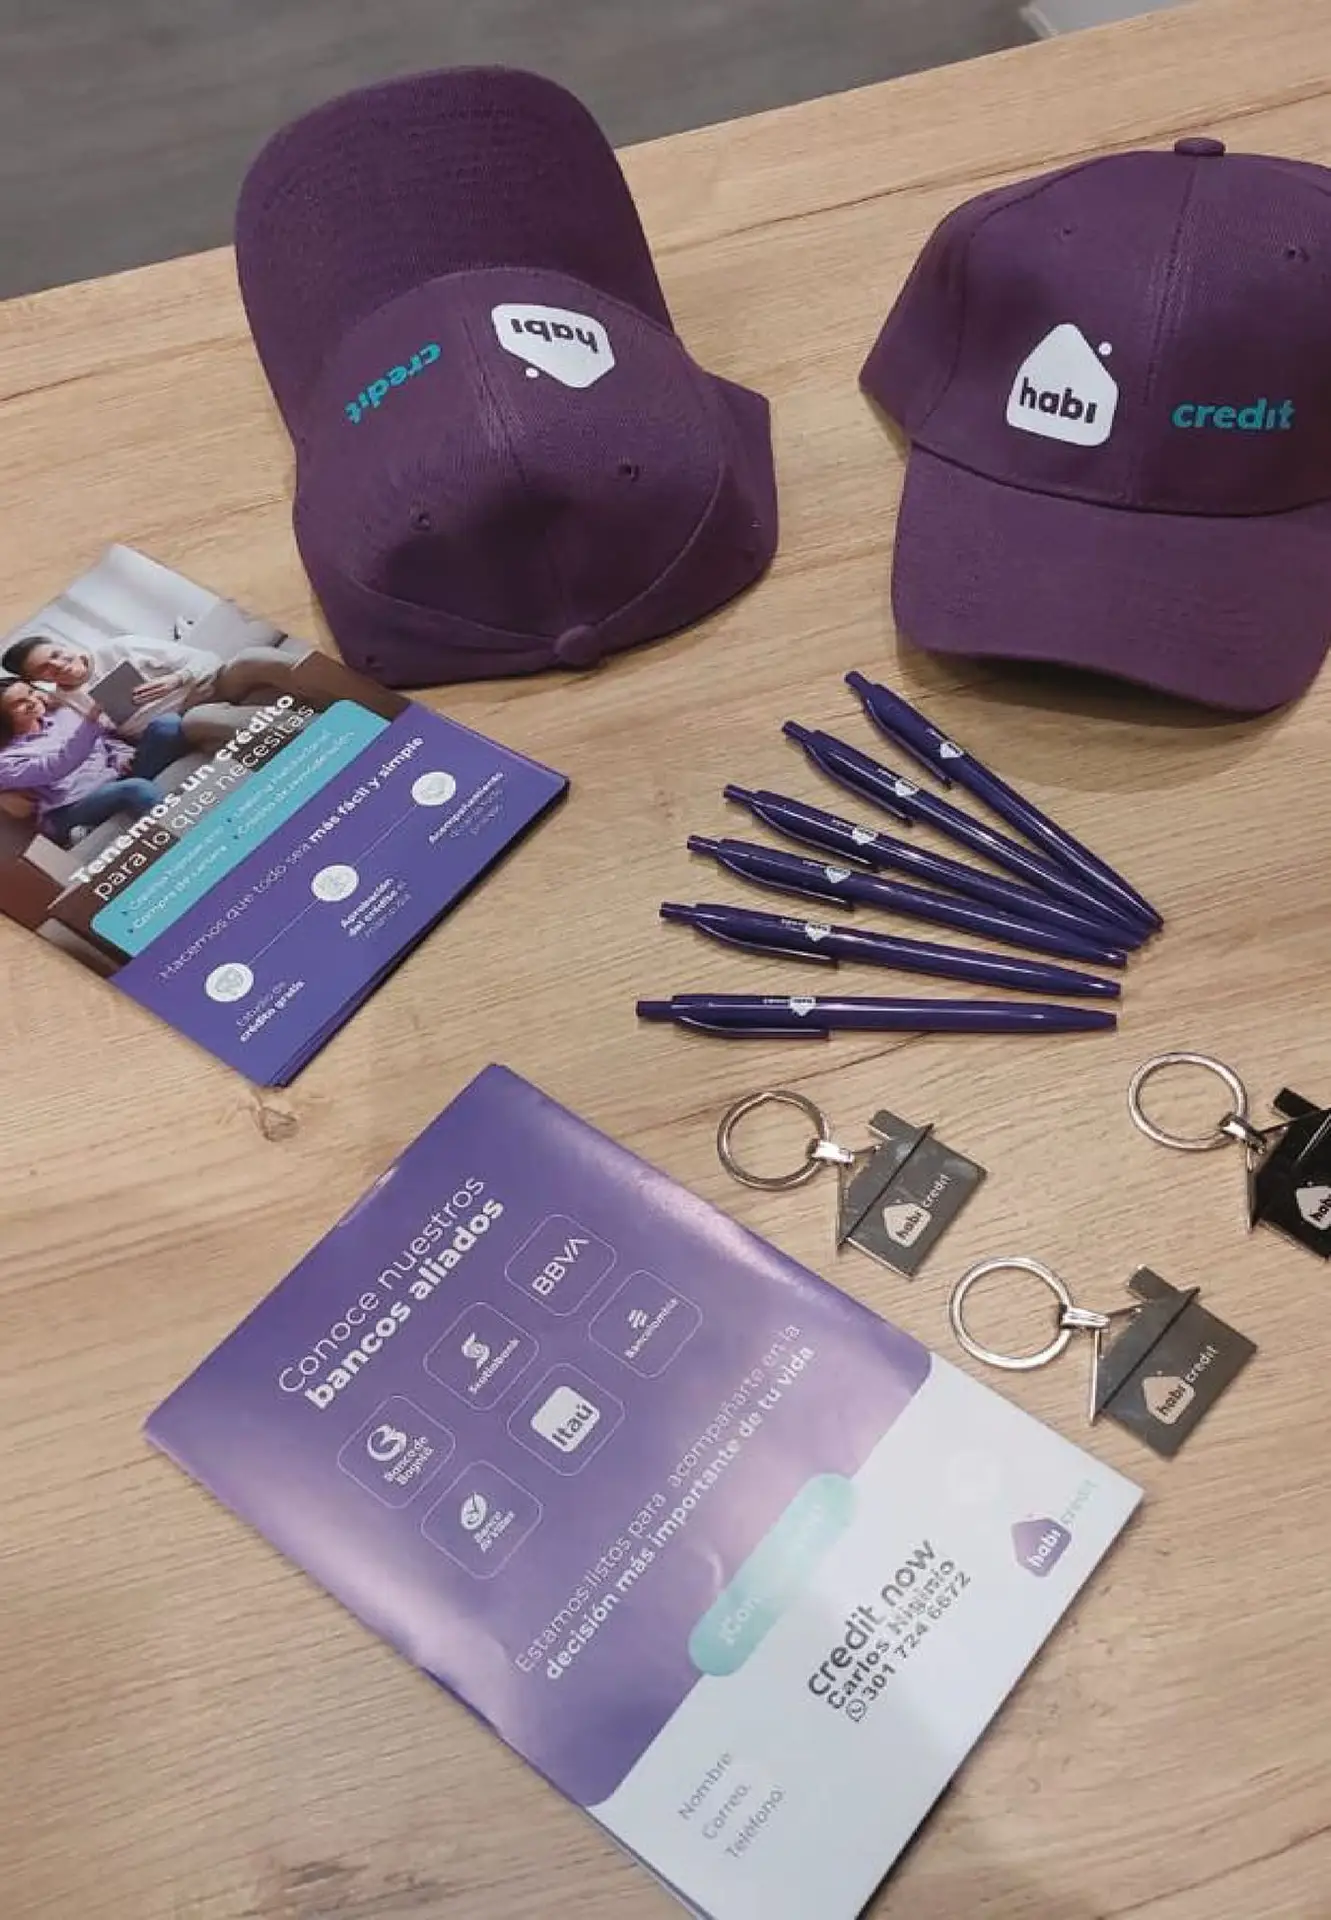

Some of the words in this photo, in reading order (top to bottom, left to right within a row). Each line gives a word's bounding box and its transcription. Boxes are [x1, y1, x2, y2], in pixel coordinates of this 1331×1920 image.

[511, 318, 599, 353] habi
[344, 342, 442, 424] credit
[1018, 376, 1097, 424] habi
[1171, 397, 1296, 430] credit
[69, 792, 182, 884] Tenemos
[180, 764, 216, 792] un
[215, 695, 295, 761] crédito
[94, 851, 147, 901] para
[141, 832, 171, 851] lo
[170, 790, 220, 830] que
[216, 705, 315, 790] necesitas
[159, 918, 229, 979] Hacemos
[226, 892, 254, 922] que
[252, 863, 288, 894] todo
[285, 842, 311, 867] sea
[308, 814, 341, 843] más
[338, 786, 371, 817] fácil
[369, 777, 382, 791] y
[378, 736, 425, 778] simple
[1309, 1193, 1331, 1222] hab
[278, 1292, 379, 1392] Conoce
[377, 1177, 485, 1290] nuestros
[532, 1239, 589, 1296] BBVA
[304, 1301, 411, 1409] bancos
[409, 1199, 504, 1300] aliados
[550, 1402, 594, 1447] Itaú
[1156, 1384, 1186, 1417] habi
[384, 1448, 416, 1482] Banco
[413, 1436, 428, 1451] de
[547, 1593, 620, 1679] decisión
[616, 1548, 655, 1592] más
[648, 1438, 740, 1548] importante
[738, 1411, 763, 1438] de
[758, 1387, 782, 1410] tu
[777, 1346, 815, 1385] vida
[1026, 1528, 1061, 1567] habi
[514, 1584, 590, 1672] Estamos
[584, 1537, 632, 1588] listos
[628, 1492, 667, 1539] para
[808, 1605, 888, 1697] credit
[881, 1540, 935, 1607] now
[827, 1641, 890, 1709] Carlos
[862, 1663, 896, 1701] 301
